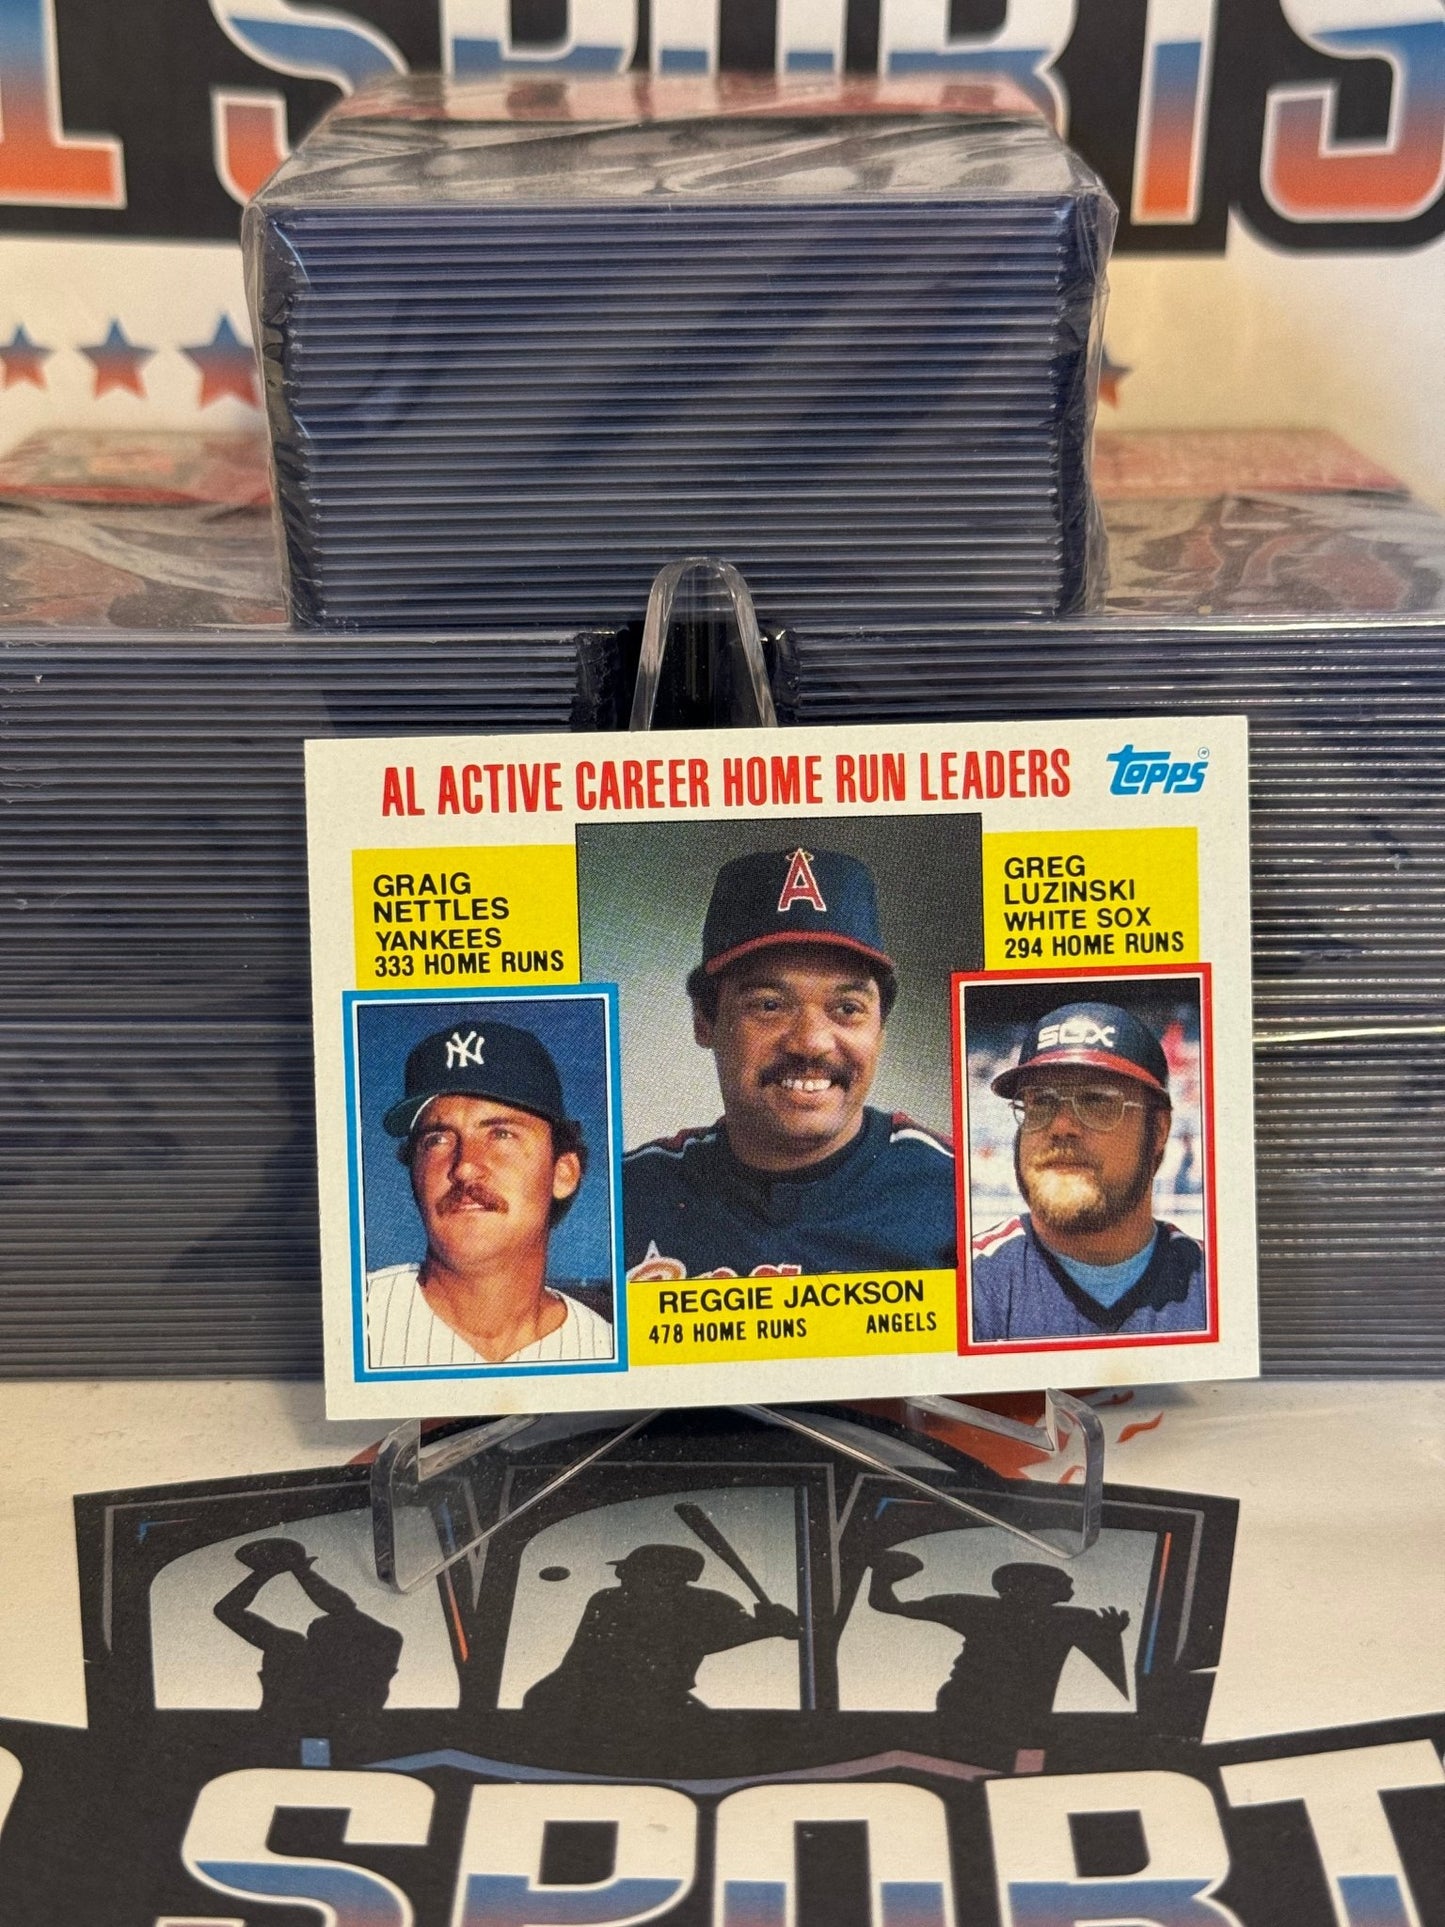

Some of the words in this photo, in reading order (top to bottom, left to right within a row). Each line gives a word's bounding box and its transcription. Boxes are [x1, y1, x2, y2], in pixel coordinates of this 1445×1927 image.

[383, 767, 424, 816] AL
[438, 763, 562, 814] ACTIVE
[576, 759, 709, 810] CAREER
[724, 756, 822, 806] HOME
[836, 753, 905, 802] RUN
[921, 749, 1070, 800] LEADERS
[778, 847, 826, 911] A
[1005, 855, 1085, 879] GREG
[374, 872, 470, 897] GRAIG
[1005, 880, 1134, 904] LUZINSKI
[374, 897, 509, 923] NETTLES
[1004, 910, 1086, 931] WHITE
[1098, 907, 1151, 928] SOX
[376, 928, 501, 951] YANKEES
[1005, 938, 1042, 958] 294
[1053, 934, 1114, 956] HOME
[1126, 931, 1183, 953] RUNS
[375, 955, 414, 977] 333
[425, 952, 490, 974] HOME
[502, 950, 563, 972] RUNS
[1037, 1018, 1115, 1050] SOX
[660, 1287, 772, 1313] REGGIE
[784, 1280, 923, 1308] JACKSON
[649, 1324, 683, 1343] 478
[694, 1322, 746, 1342] HOME
[758, 1318, 806, 1338] RUNS
[867, 1312, 936, 1333] ANGELS
